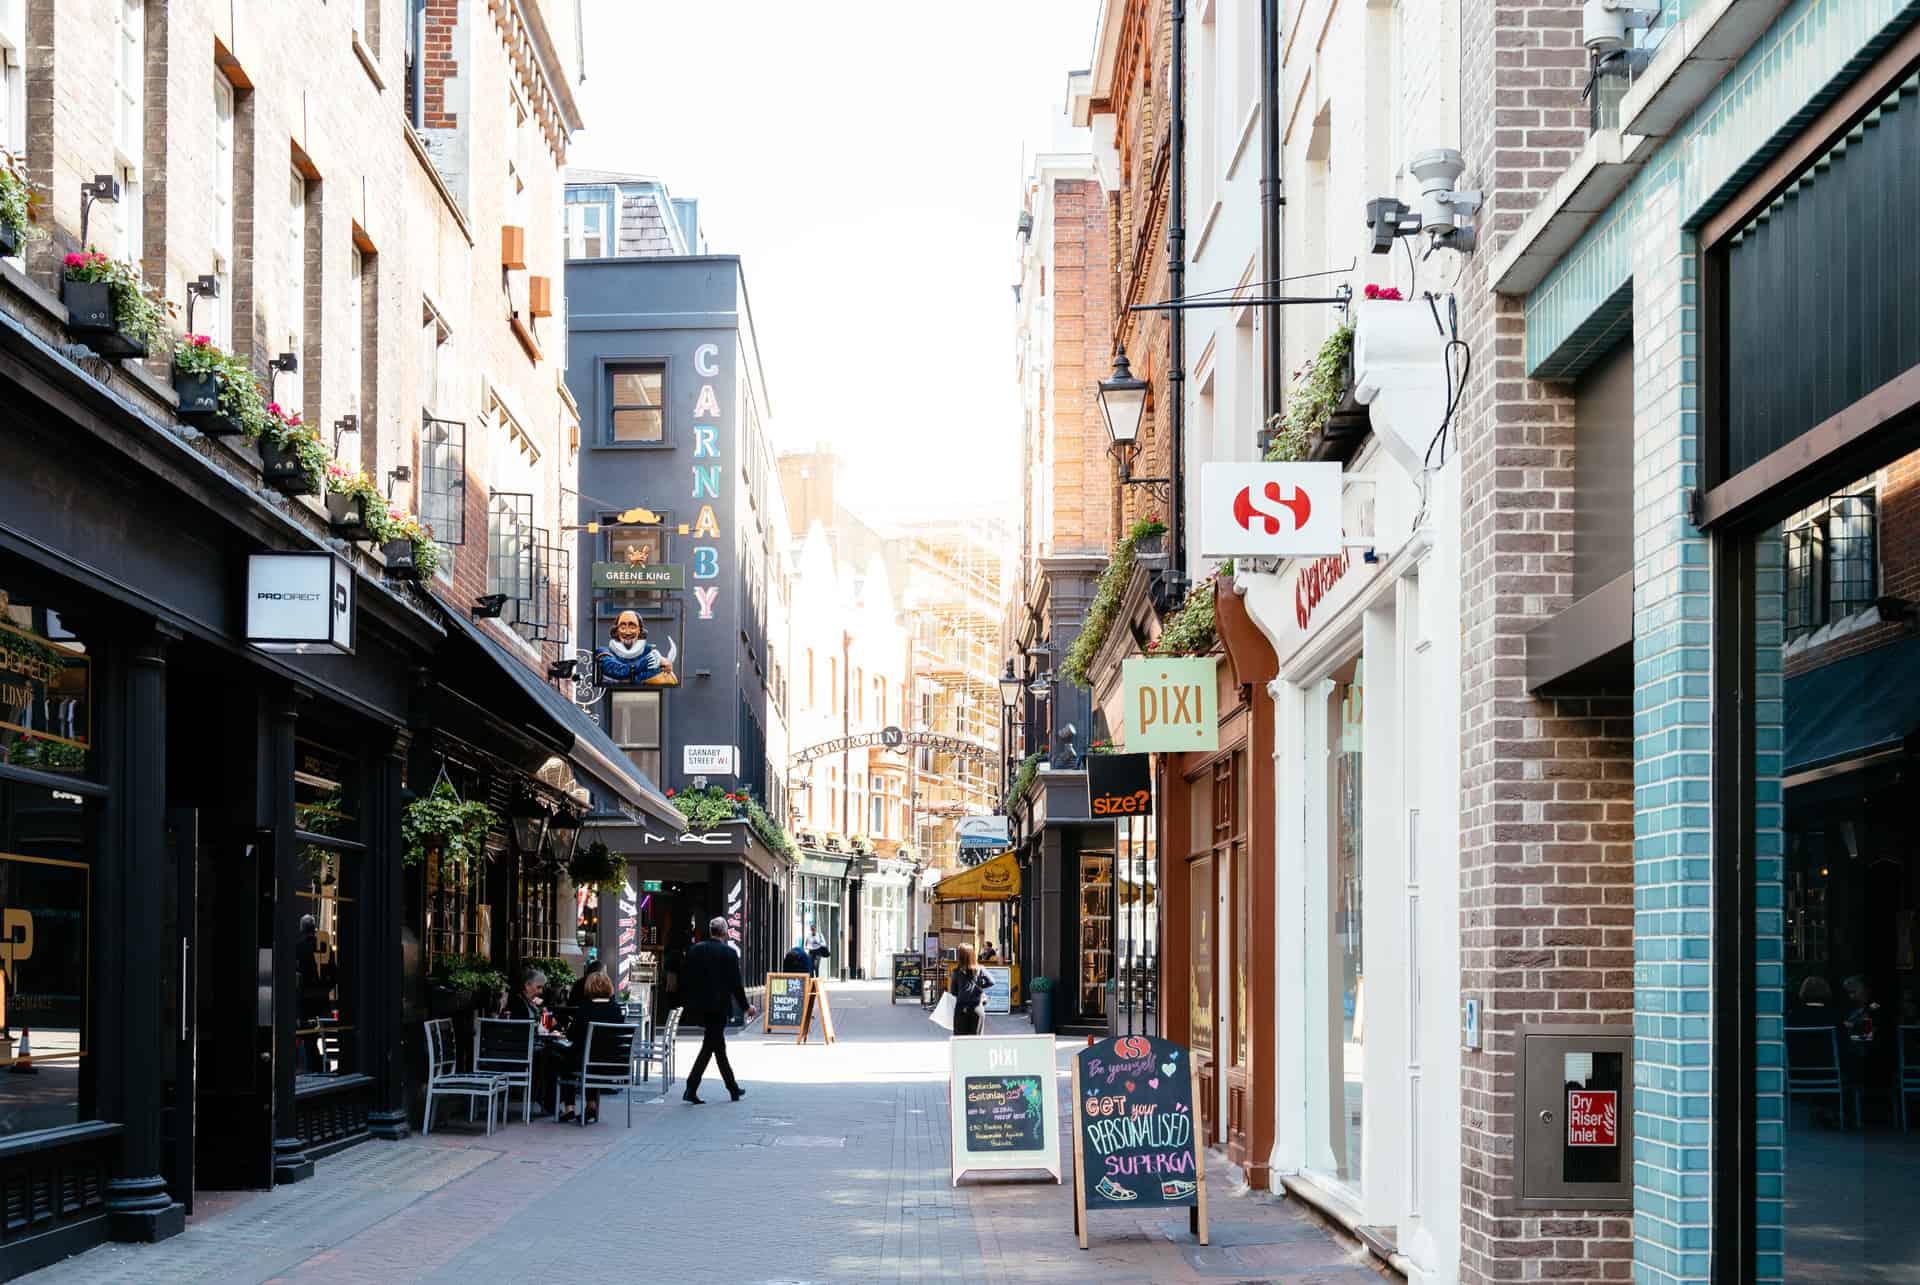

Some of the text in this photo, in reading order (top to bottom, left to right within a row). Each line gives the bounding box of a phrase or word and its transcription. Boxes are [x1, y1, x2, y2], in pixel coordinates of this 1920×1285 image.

[692, 342, 721, 620] CARNABY
[606, 571, 672, 580] GREENE KING
[688, 748, 721, 757] CARNABY
[688, 757, 714, 765] STREET
[1093, 790, 1150, 815] size?
[1130, 1102, 1158, 1122] your
[1571, 1093, 1592, 1113] Dry
[1571, 1110, 1603, 1126] Riser
[1087, 1112, 1191, 1156] PERSONALISED
[1571, 1127, 1597, 1143] Inlet
[1104, 1150, 1195, 1176] SUPERGA
